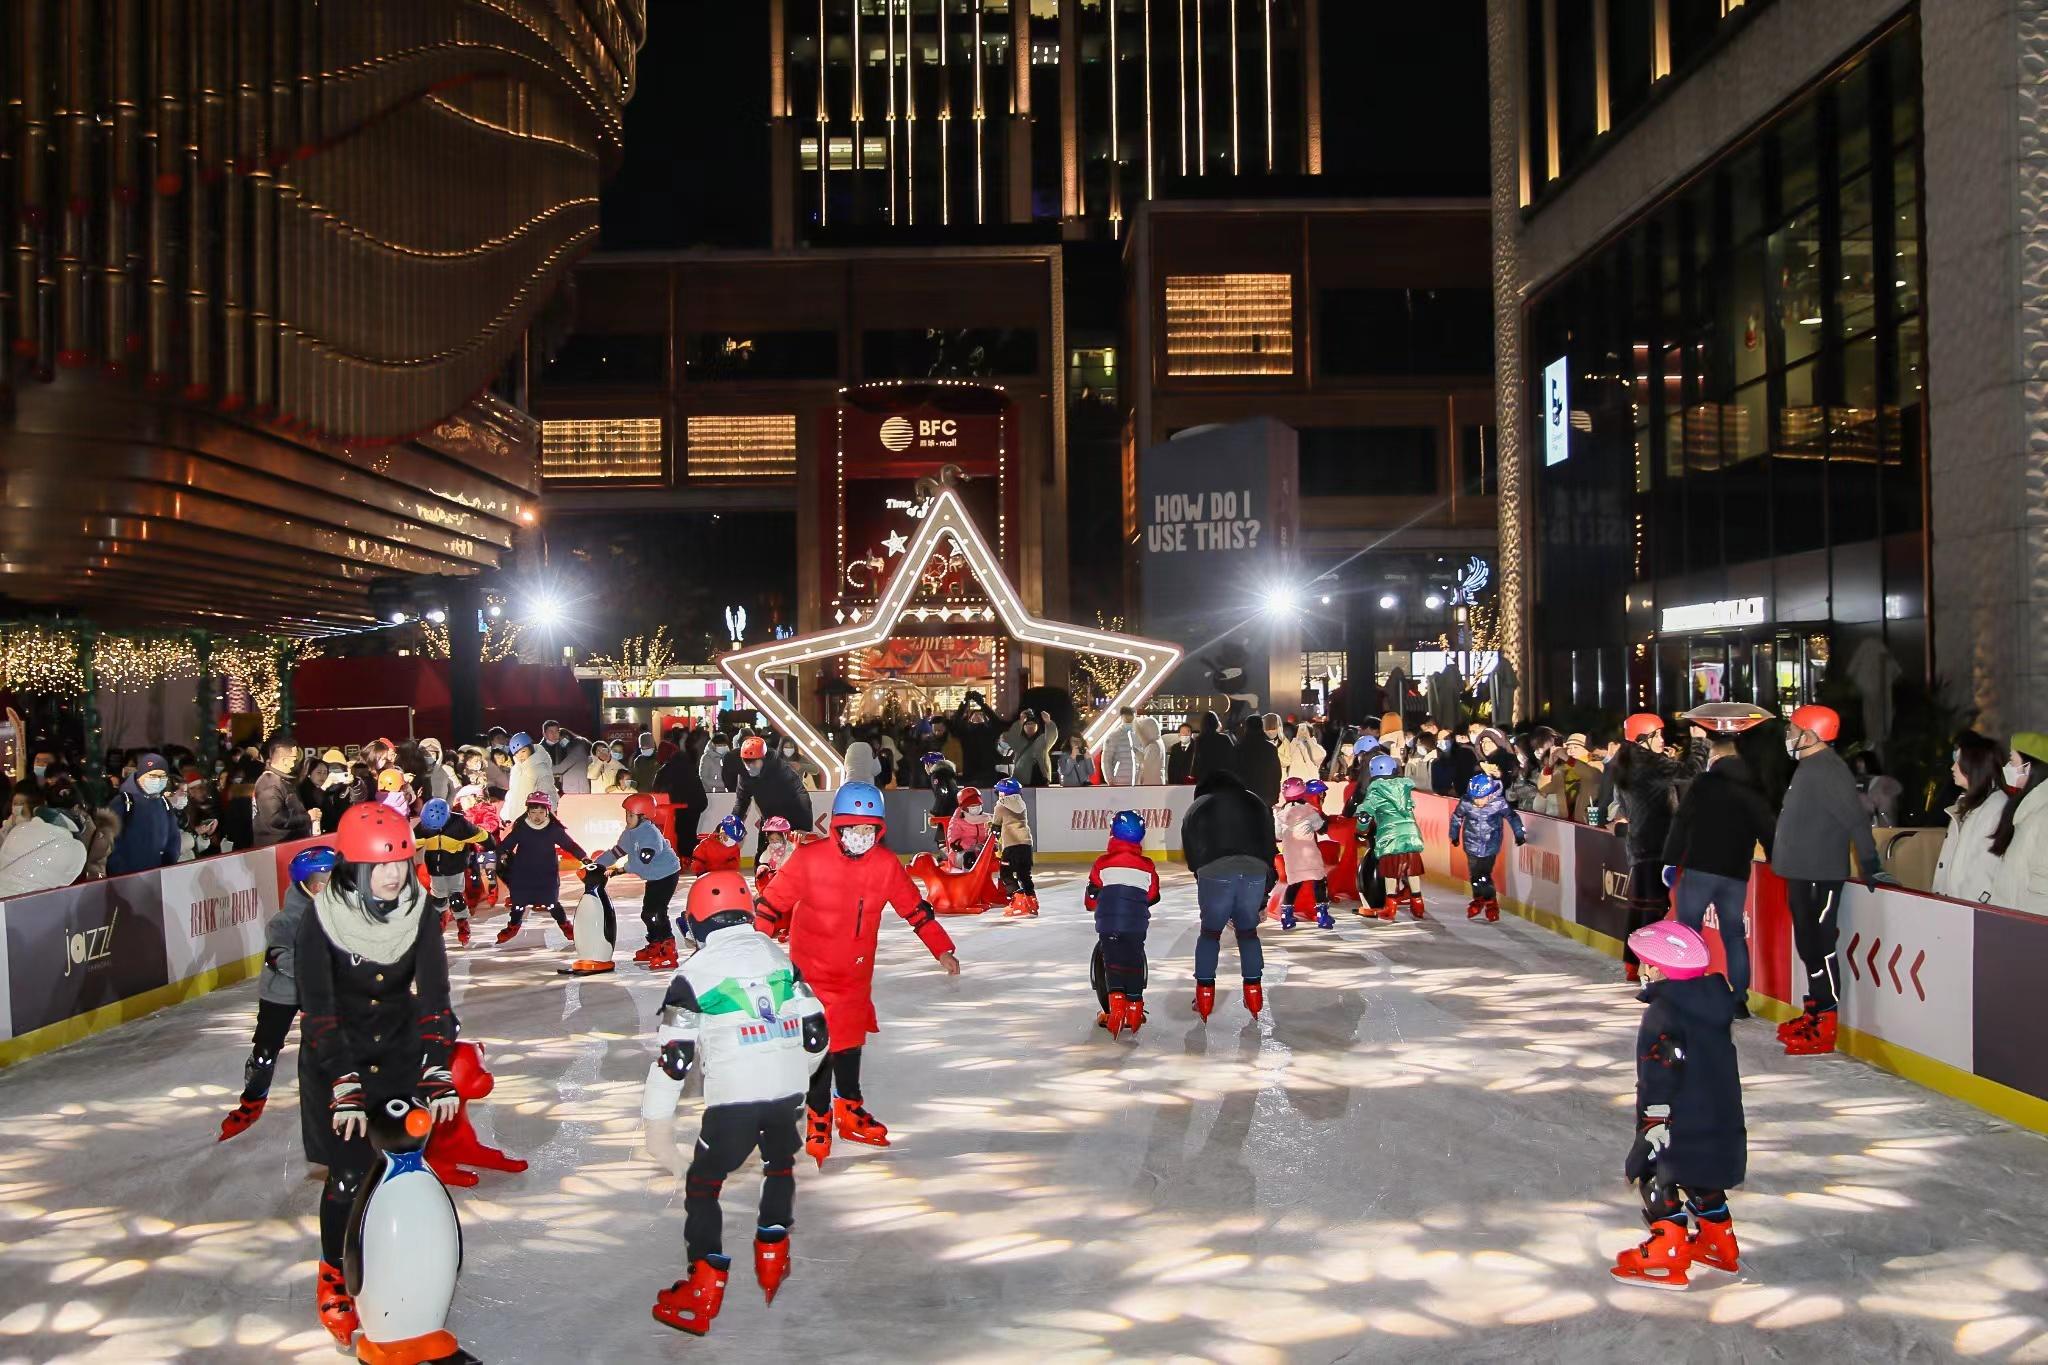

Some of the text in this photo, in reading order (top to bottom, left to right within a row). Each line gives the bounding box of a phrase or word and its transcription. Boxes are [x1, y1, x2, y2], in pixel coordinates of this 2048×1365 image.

[920, 420, 957, 436] BFC
[1155, 493, 1204, 523] HOW
[1210, 491, 1236, 520] DO
[1243, 489, 1251, 519] I
[1148, 520, 1261, 553] USE THIS?
[1071, 809, 1109, 830] RINK
[191, 898, 217, 938] RINK
[231, 887, 258, 927] BUND
